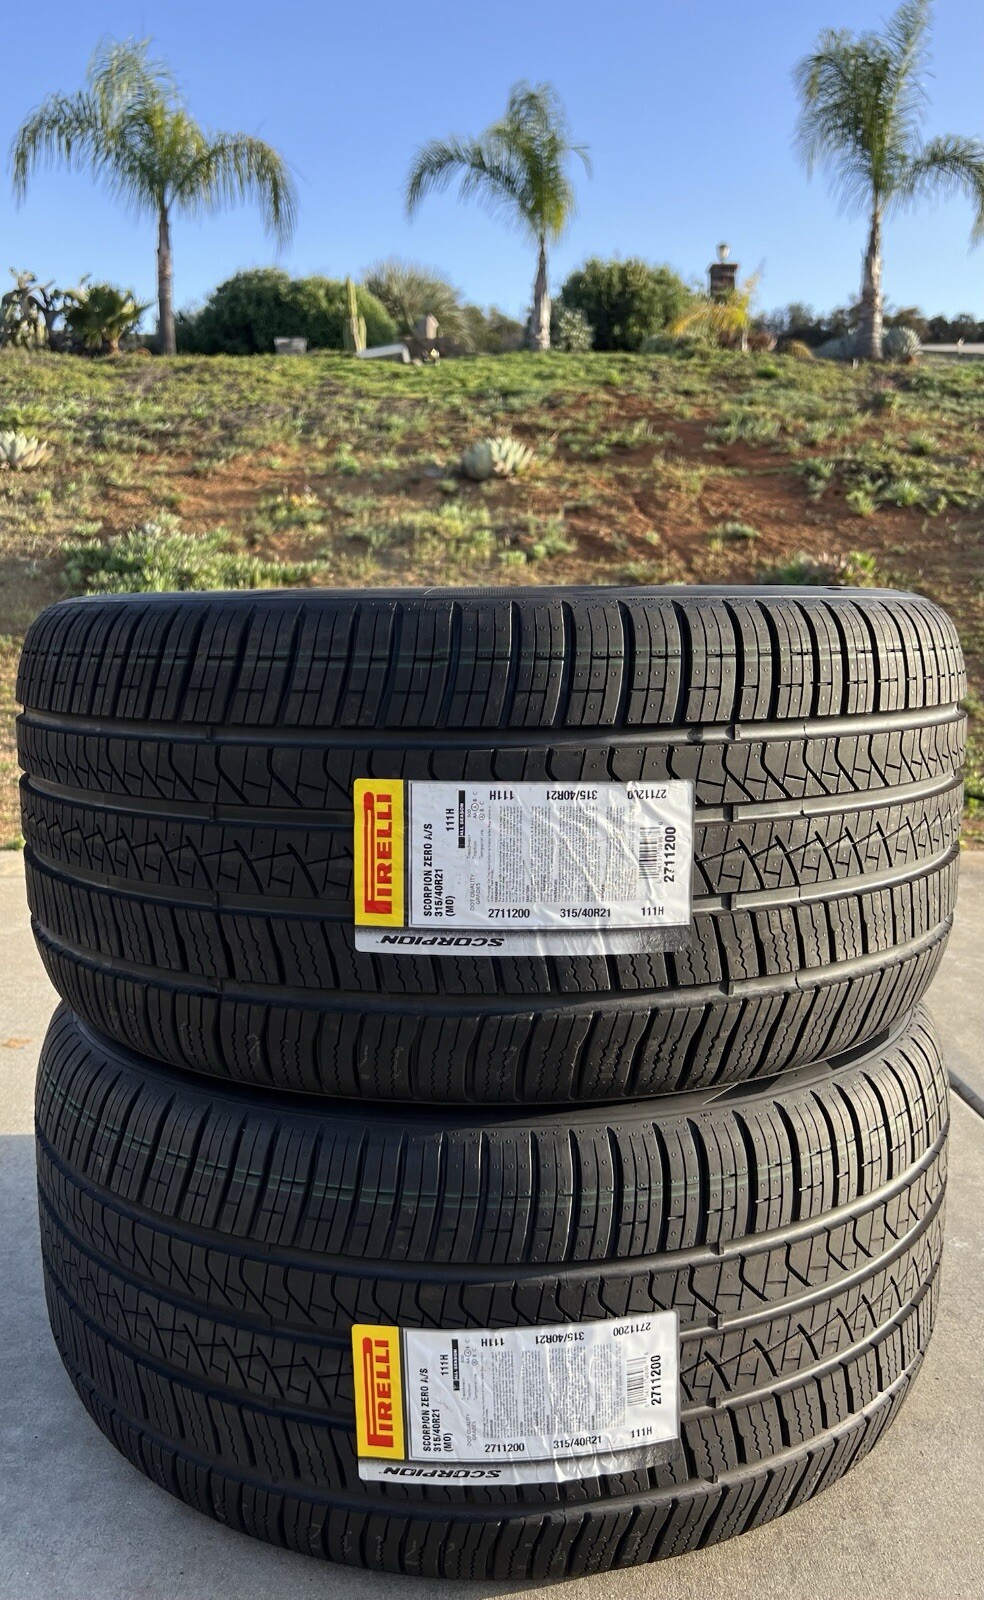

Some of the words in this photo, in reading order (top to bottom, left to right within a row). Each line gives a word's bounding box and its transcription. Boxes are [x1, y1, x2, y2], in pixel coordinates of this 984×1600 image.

[489, 790, 514, 800] 111H
[547, 790, 597, 800] 315/40R21
[627, 789, 667, 800] 2711200
[446, 809, 455, 832] 111H
[423, 823, 432, 840] A/S
[364, 792, 392, 914] PIRELLI
[423, 844, 432, 867] ZERO
[664, 827, 676, 882] 2711200
[423, 870, 432, 917] SCORPION
[435, 868, 443, 917] 315/40R21
[446, 895, 455, 917] (MO)
[488, 908, 530, 918] 2711200
[560, 908, 611, 918] 315/40R21
[642, 906, 664, 916] 111H
[380, 935, 505, 947] SCORPION
[536, 1331, 584, 1344] 315/40R21
[613, 1322, 651, 1337] 2711200
[481, 1338, 505, 1347] 111H
[440, 1354, 449, 1376] 111H
[420, 1368, 428, 1383] A/S
[651, 1355, 662, 1406] 2711200
[362, 1337, 394, 1447] PIRELLI
[421, 1385, 429, 1407] ZERO
[422, 1409, 431, 1451] SCORPION
[432, 1409, 442, 1451] 315/40R21
[631, 1426, 653, 1439] 111H
[443, 1433, 453, 1452] (MO)
[485, 1443, 524, 1452] 2711200
[553, 1435, 602, 1449] 315/40R21
[383, 1467, 501, 1478] SCORPION
